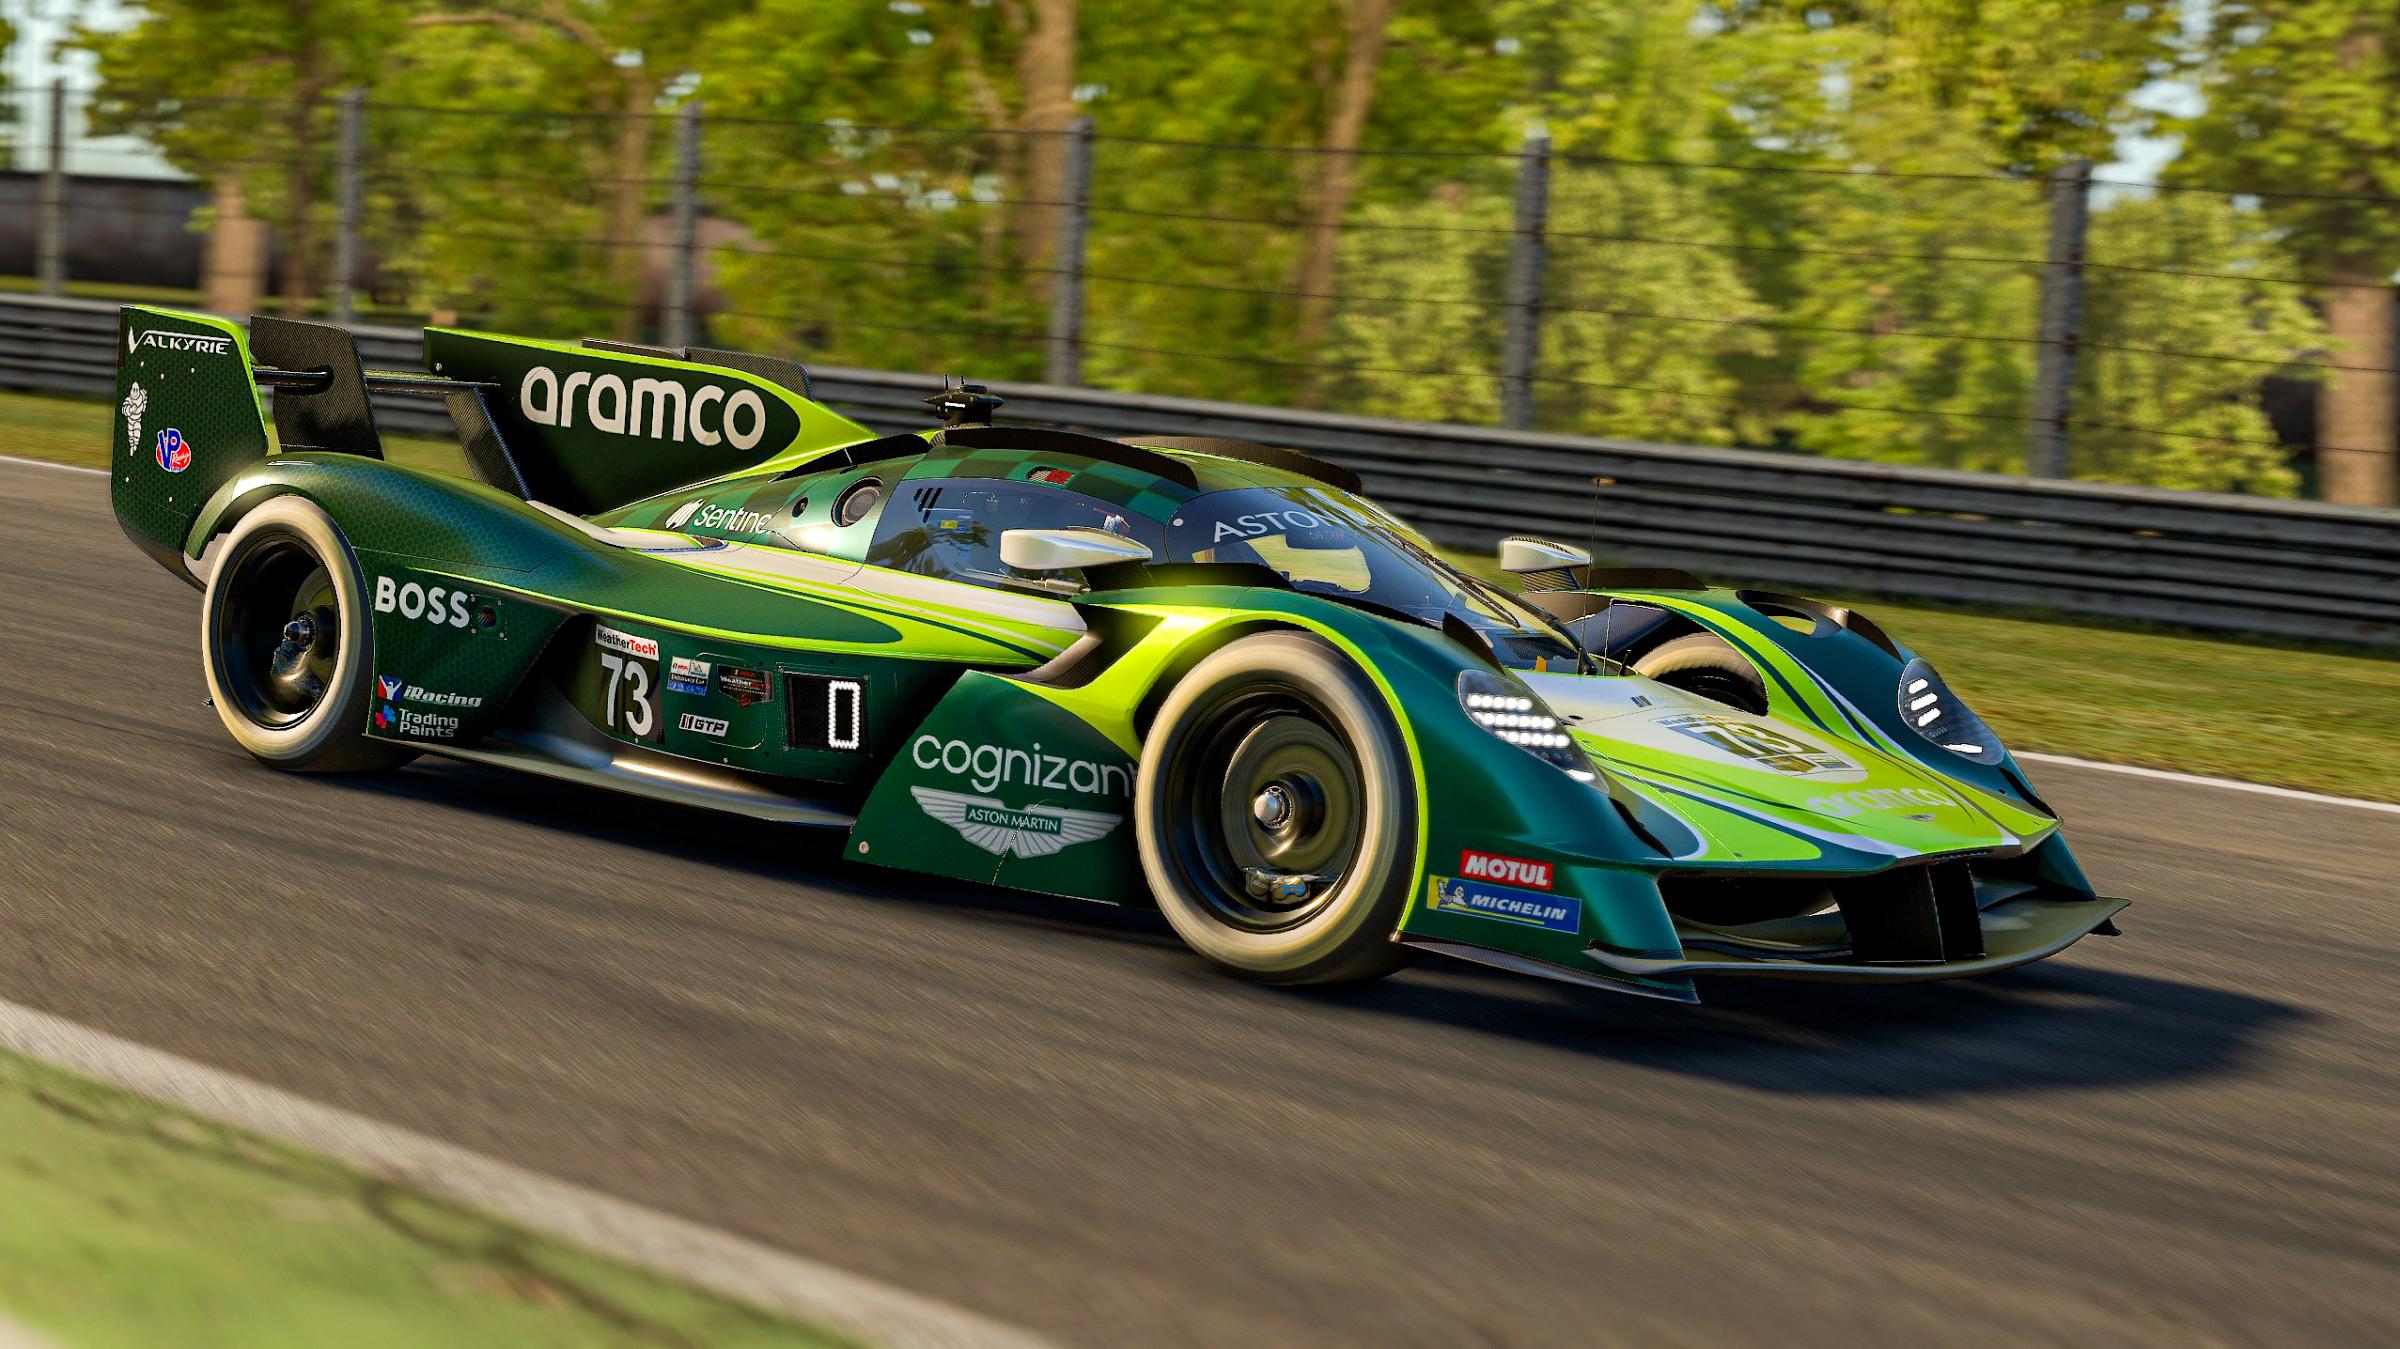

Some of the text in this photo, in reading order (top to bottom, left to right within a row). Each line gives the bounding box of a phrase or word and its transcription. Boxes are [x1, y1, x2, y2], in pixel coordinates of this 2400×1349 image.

[128, 326, 231, 354] VALKYRIE
[520, 365, 766, 450] aramco
[157, 428, 182, 470] VP
[694, 503, 773, 534] Sentine
[1213, 510, 1348, 543] ASTON
[375, 575, 470, 628] BOSS
[597, 628, 657, 656] WeatherTech
[601, 652, 653, 736] 73
[719, 675, 772, 689] Weather
[403, 685, 482, 708] iRacing
[399, 708, 459, 729] Trading
[399, 721, 455, 738] Paints
[694, 714, 725, 733] GTP
[1687, 722, 1804, 755] 73
[1807, 787, 1956, 816] aramco
[968, 808, 1059, 832] ASTON MARTIN
[1464, 854, 1548, 886] MOTUL
[1471, 893, 1567, 921] MICHELIN
